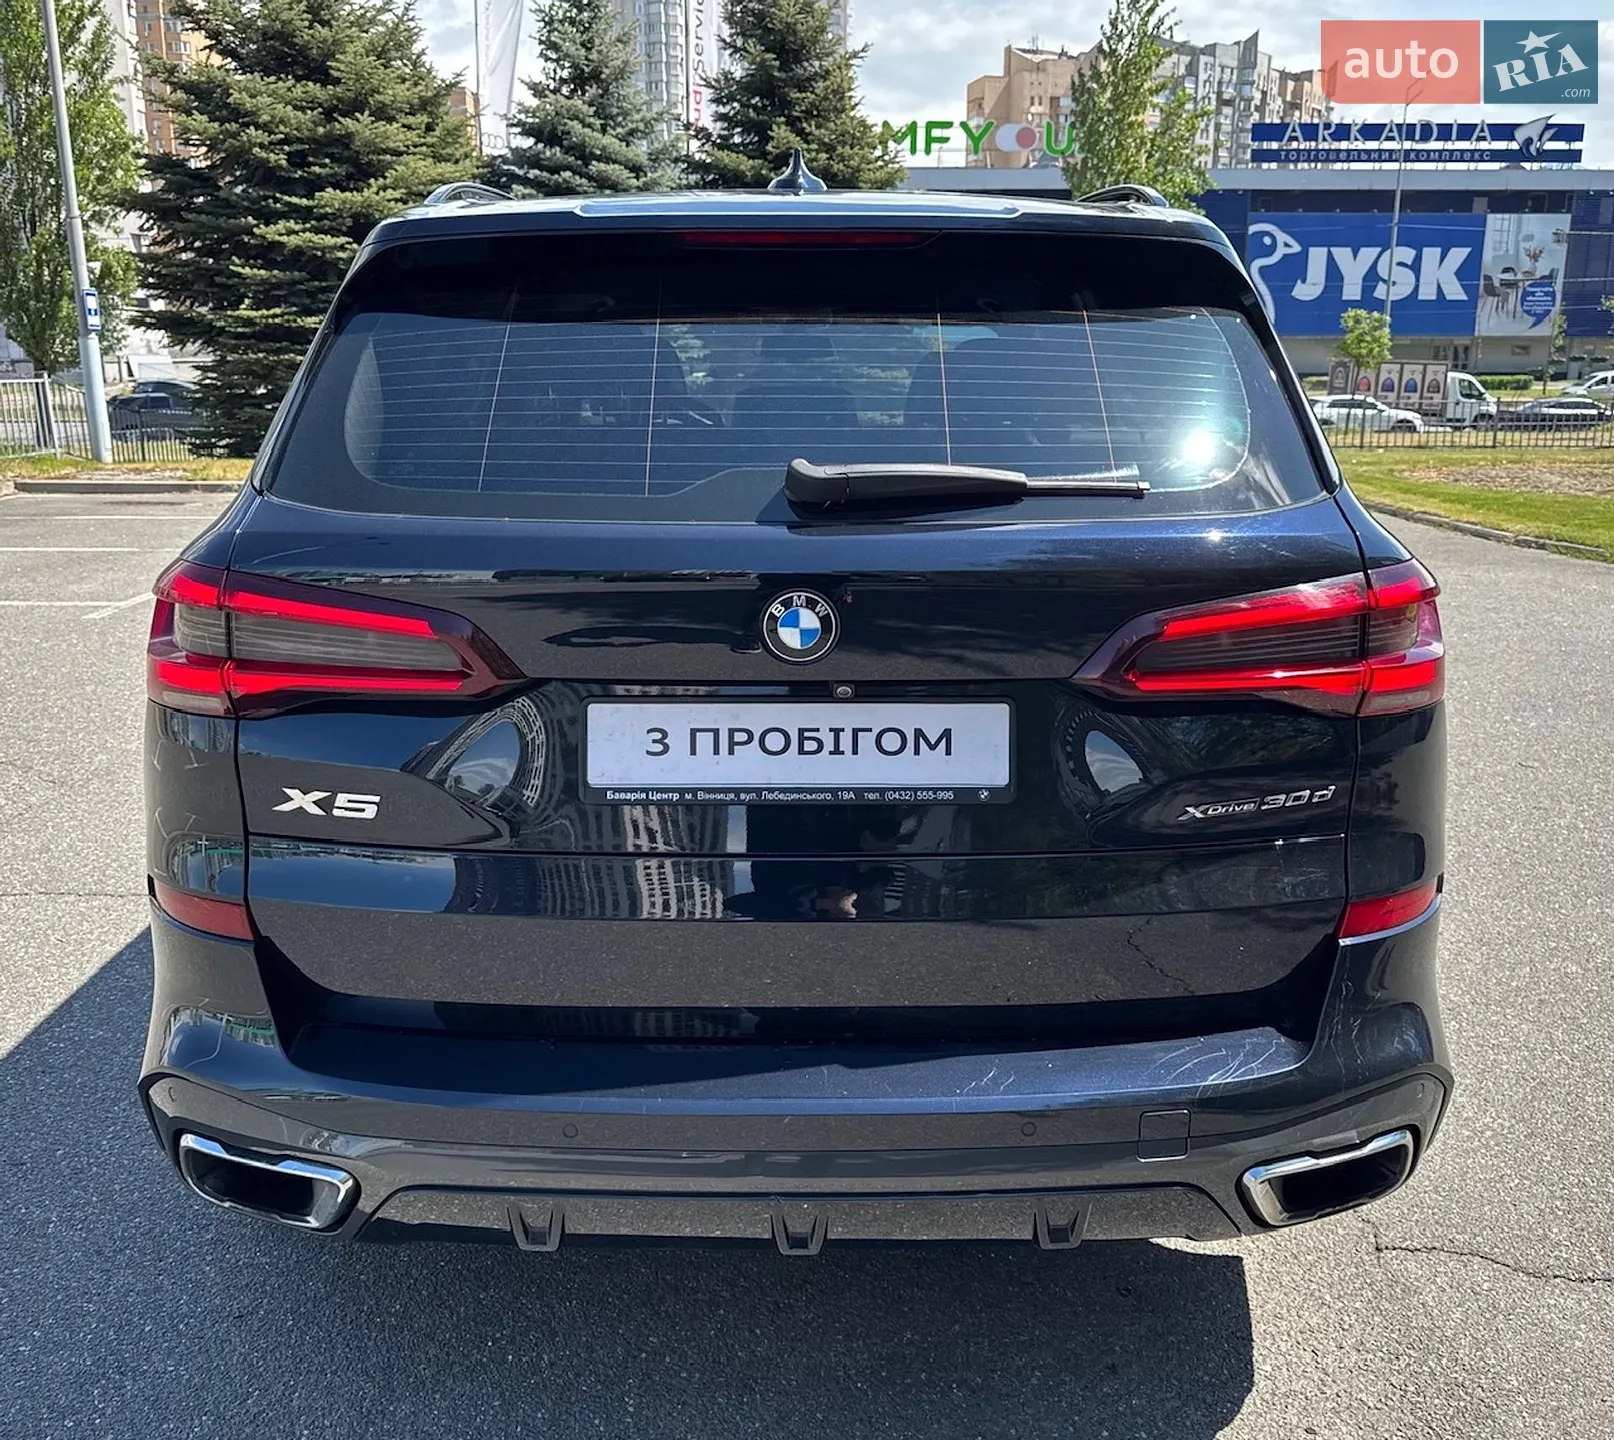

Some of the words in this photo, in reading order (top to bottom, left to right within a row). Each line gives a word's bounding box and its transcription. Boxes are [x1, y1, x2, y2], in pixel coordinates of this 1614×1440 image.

[1281, 119, 1492, 144] ARKADIA
[1409, 151, 1491, 160] комплекс
[1291, 247, 1472, 301] JYSK
[771, 595, 828, 617] BMW
[645, 727, 671, 756] З
[689, 727, 953, 757] ПРОБІГОМ
[271, 787, 382, 819] X5
[606, 791, 646, 801] Баварія
[648, 791, 680, 801] Центр
[697, 791, 738, 801] Вінниця,
[884, 791, 915, 801] (0432)
[916, 791, 954, 800] 555-995
